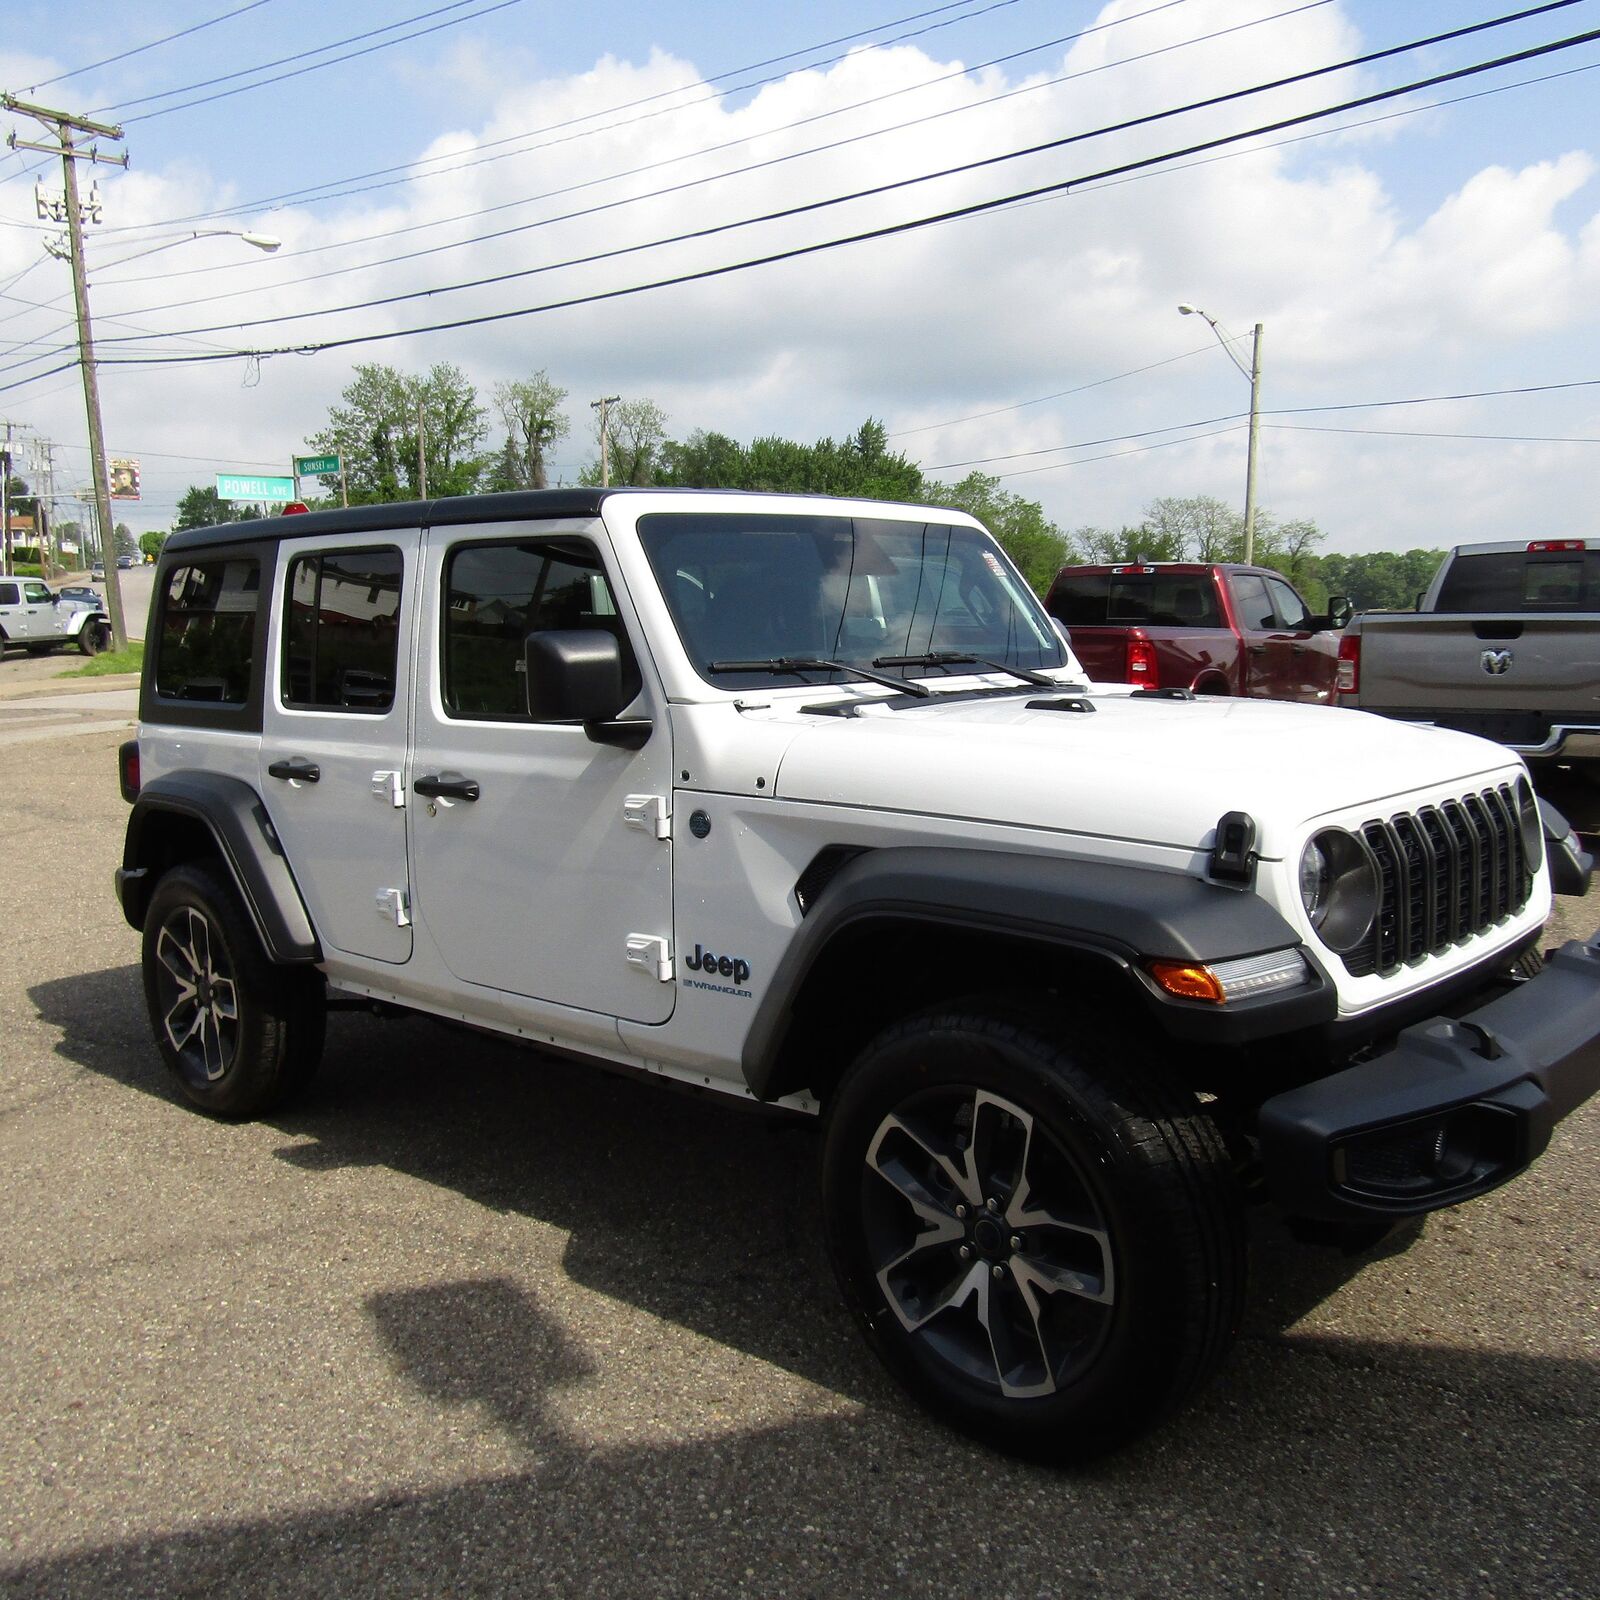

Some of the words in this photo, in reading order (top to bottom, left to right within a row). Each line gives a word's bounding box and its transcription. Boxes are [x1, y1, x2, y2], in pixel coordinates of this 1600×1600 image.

[303, 460, 325, 472] SUNSET
[224, 480, 269, 496] POWELL
[272, 486, 288, 496] AVE
[685, 944, 750, 985] Jeep
[693, 980, 752, 998] WRANGLER
